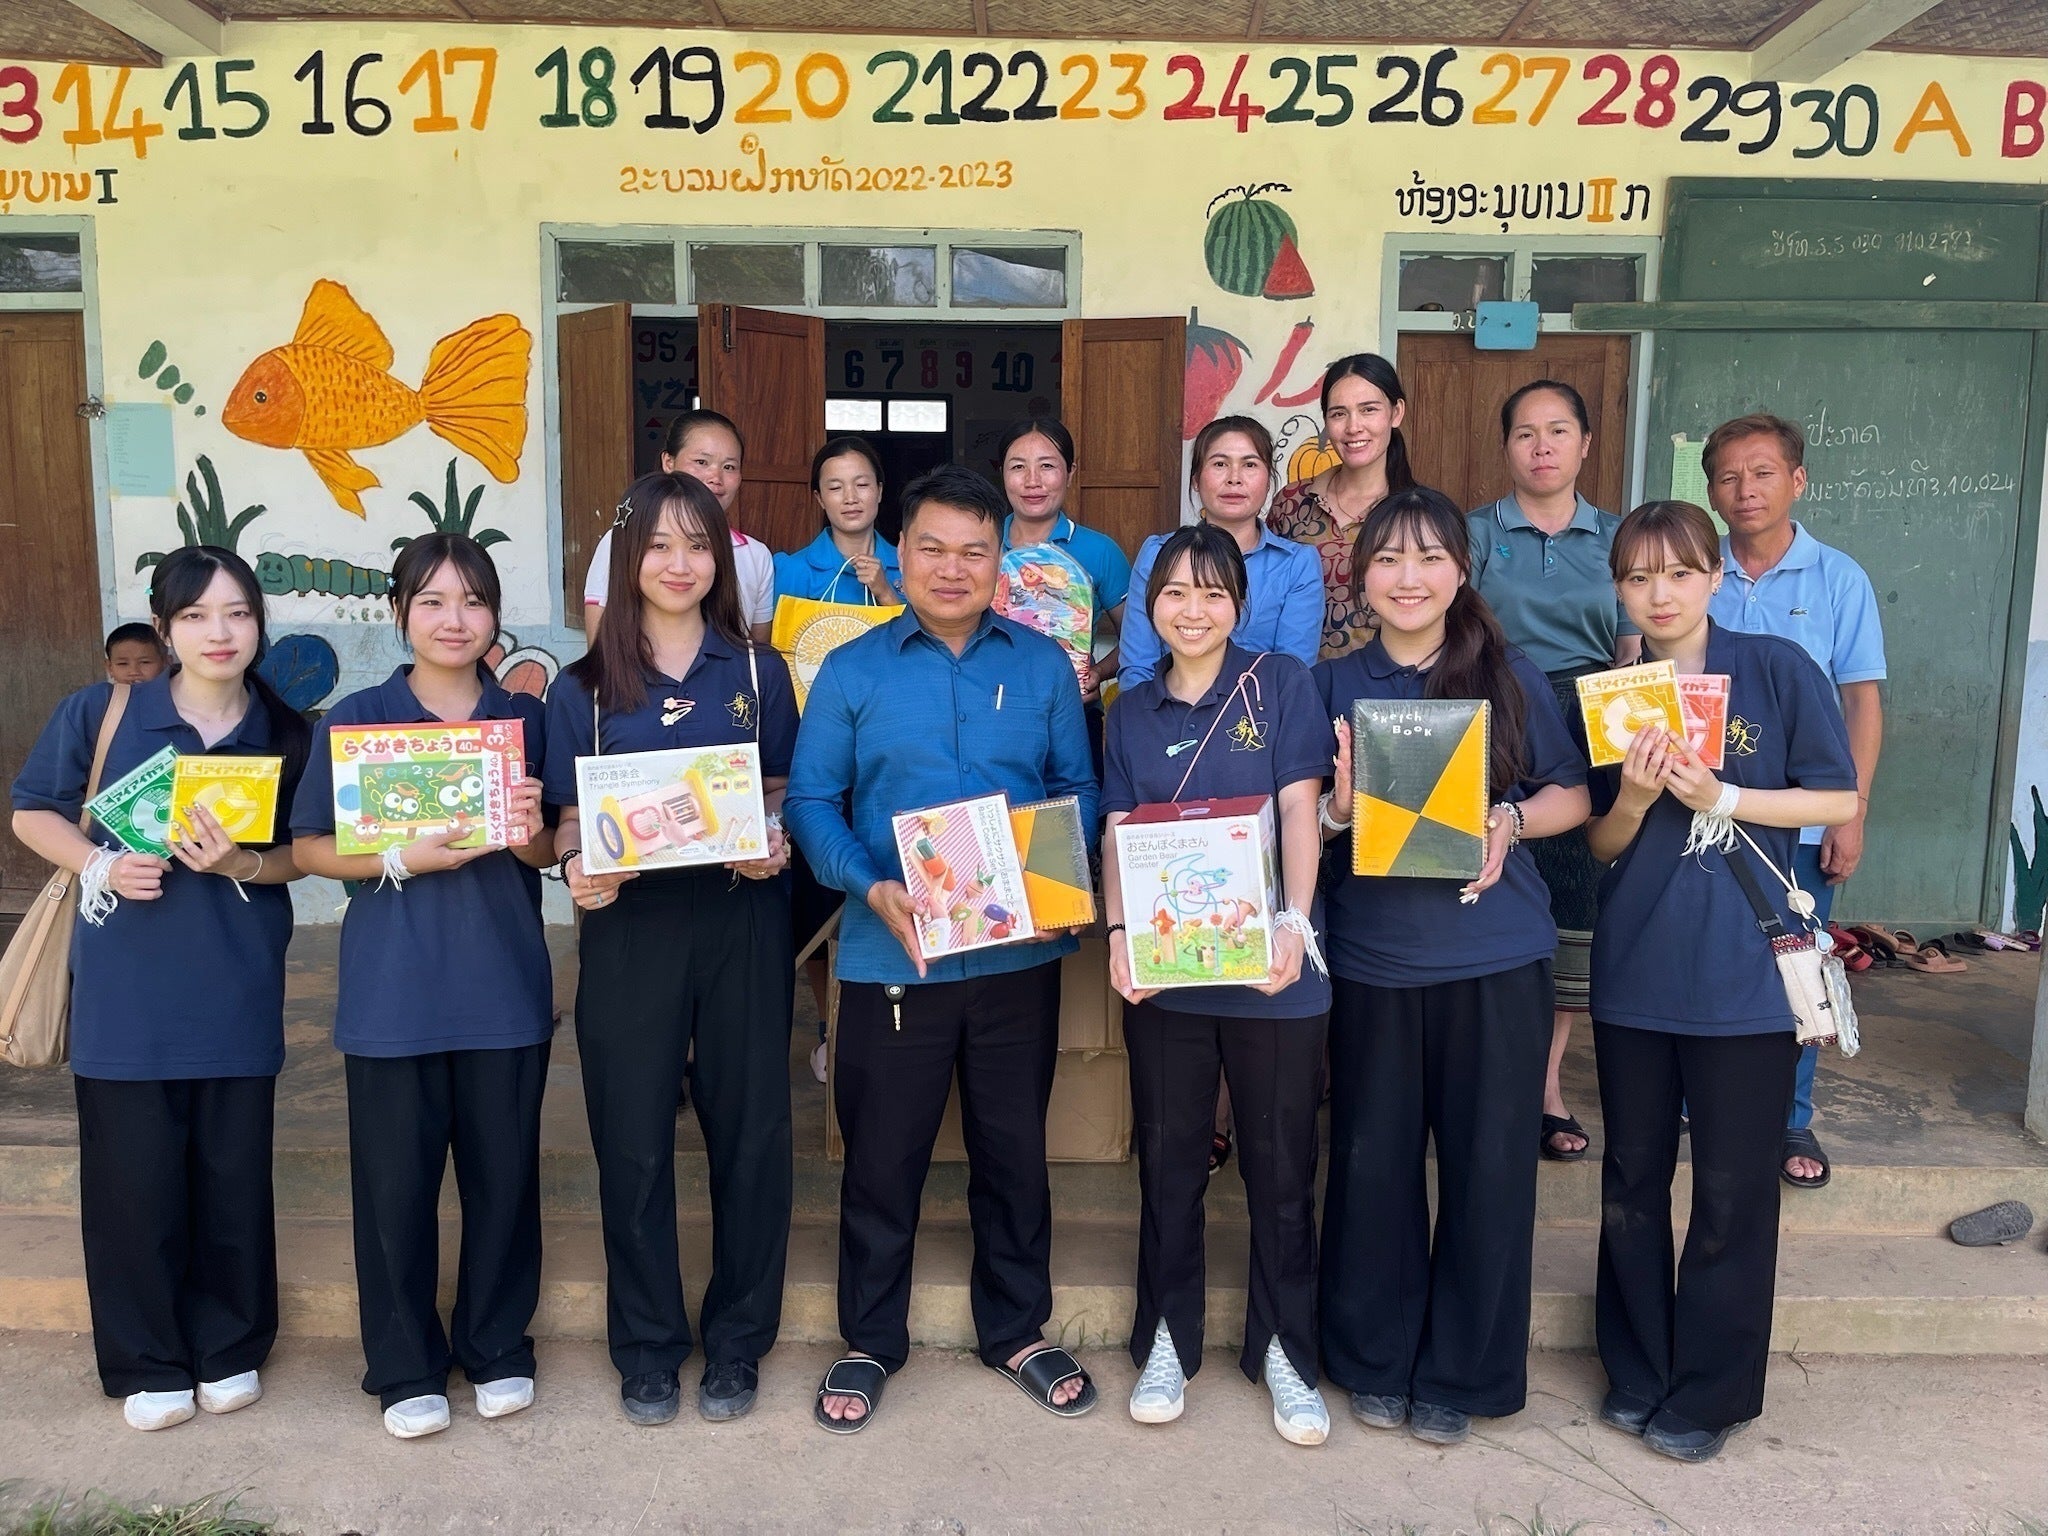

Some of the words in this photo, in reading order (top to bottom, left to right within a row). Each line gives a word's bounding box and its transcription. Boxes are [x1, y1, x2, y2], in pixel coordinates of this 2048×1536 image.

[53, 62, 164, 159] 14
[163, 59, 270, 140] 15
[294, 50, 391, 136] 16
[398, 47, 498, 132] 17
[535, 46, 617, 128] 18
[630, 46, 724, 135] 19
[734, 51, 849, 123] 20
[866, 49, 960, 125] 21
[960, 50, 1057, 122] 22
[1060, 54, 1148, 120] 23
[1164, 53, 1265, 133] 24
[1265, 55, 1358, 127] 25
[1367, 47, 1464, 127] 26
[1473, 53, 1570, 126] 27
[1577, 54, 1680, 128] 28
[1680, 76, 1782, 154] 29
[1792, 83, 1879, 158] 30
[1894, 81, 1971, 157] A
[2001, 80, 2046, 157] B
[844, 349, 865, 388] 6
[881, 350, 904, 389] 7
[921, 349, 939, 388] 8
[955, 351, 973, 388] 9
[991, 351, 1034, 392] 10
[343, 736, 453, 756] らくがきちょう
[114, 758, 173, 802] アイアイカラー
[589, 781, 620, 790] Triangle
[621, 778, 660, 788] Symphony
[489, 769, 503, 841] らくがきちょう
[1128, 853, 1158, 862] Garden
[1159, 851, 1178, 860] Bear
